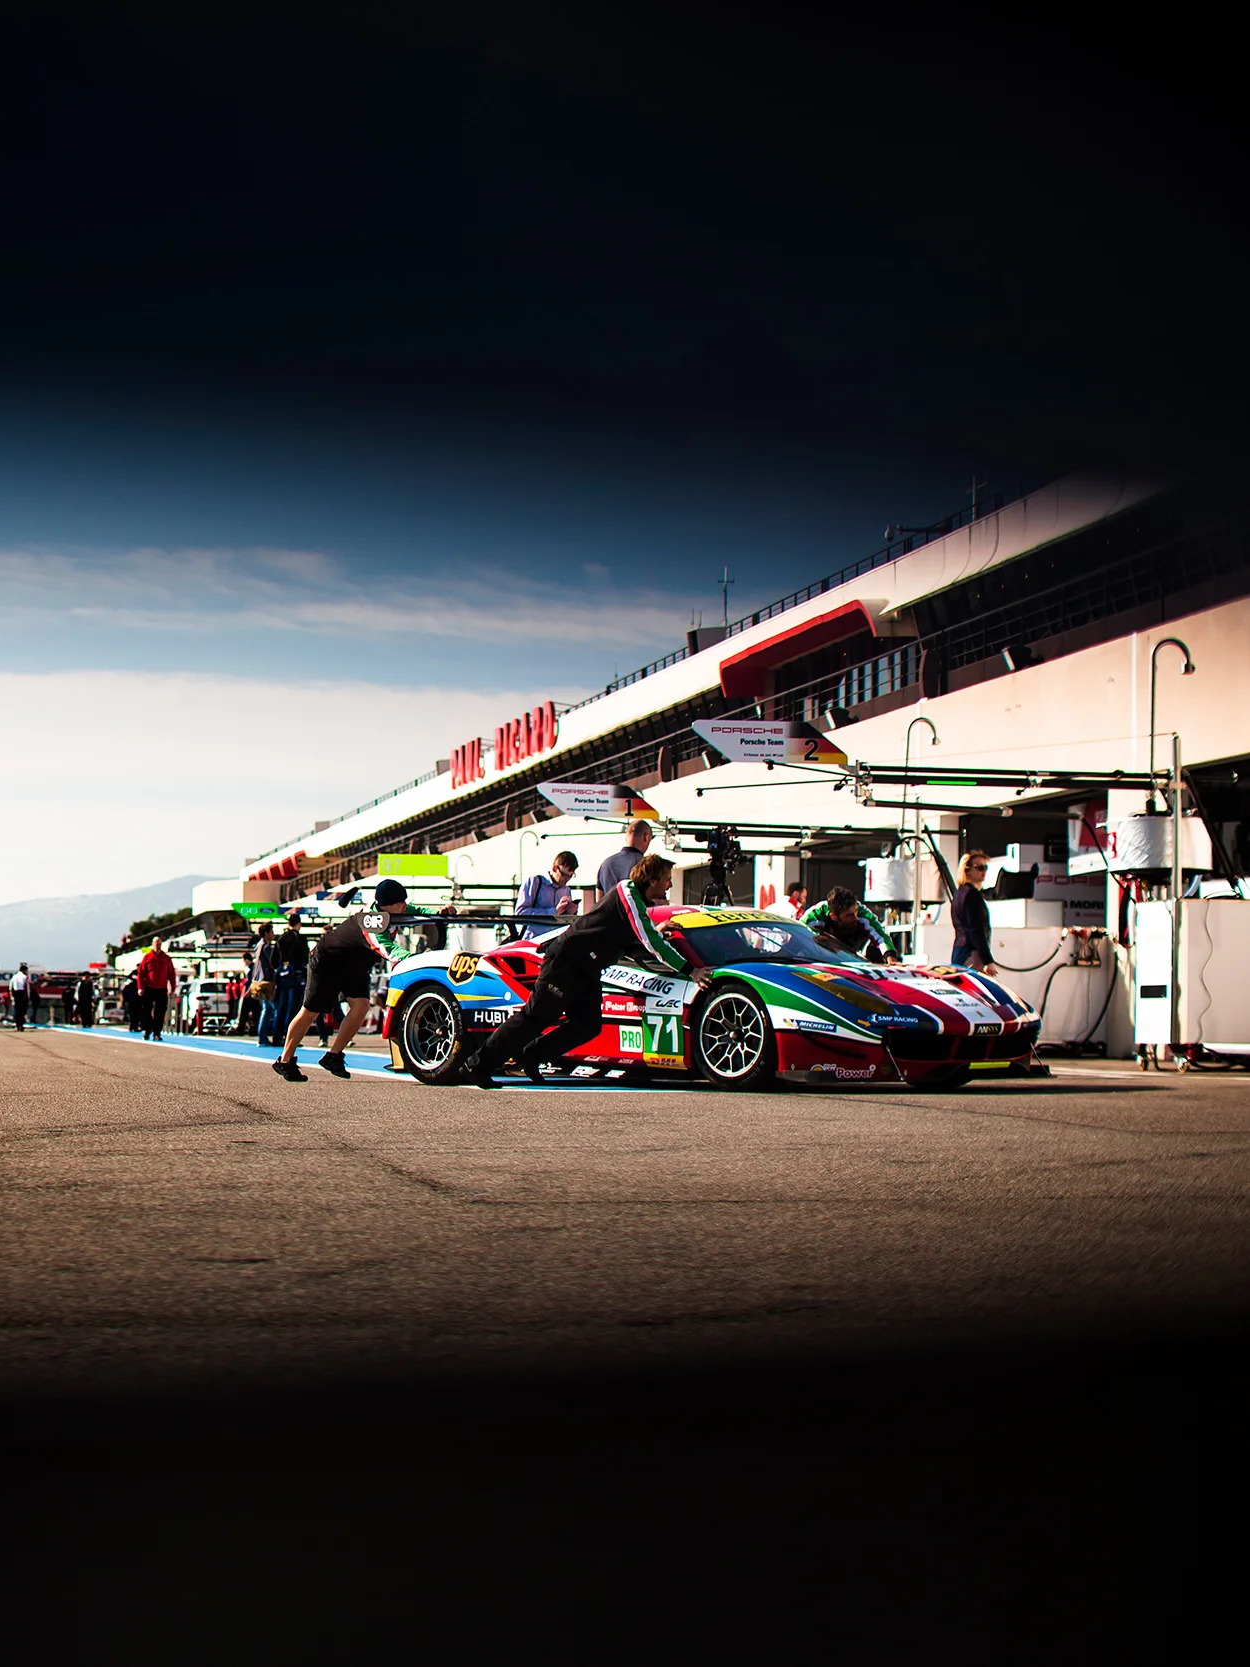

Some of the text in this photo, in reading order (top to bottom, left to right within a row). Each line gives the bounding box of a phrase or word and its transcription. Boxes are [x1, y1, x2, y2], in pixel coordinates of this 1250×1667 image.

[711, 726, 784, 735] PORSCHE
[450, 700, 559, 790] PAUL RICARD
[740, 738, 784, 746] Porsche Team
[804, 739, 820, 762] 2
[551, 787, 609, 796] PORSCHE
[596, 797, 609, 805] Team
[624, 798, 634, 817] 1
[381, 857, 403, 874] 97
[451, 955, 479, 979] ups
[626, 972, 675, 995] RACING
[655, 999, 681, 1009] WEC
[798, 1020, 835, 1031] MICHELIN
[893, 1015, 919, 1023] RACING
[621, 1030, 642, 1049] PRO
[646, 1015, 679, 1053] 71
[835, 1066, 875, 1079] Power
